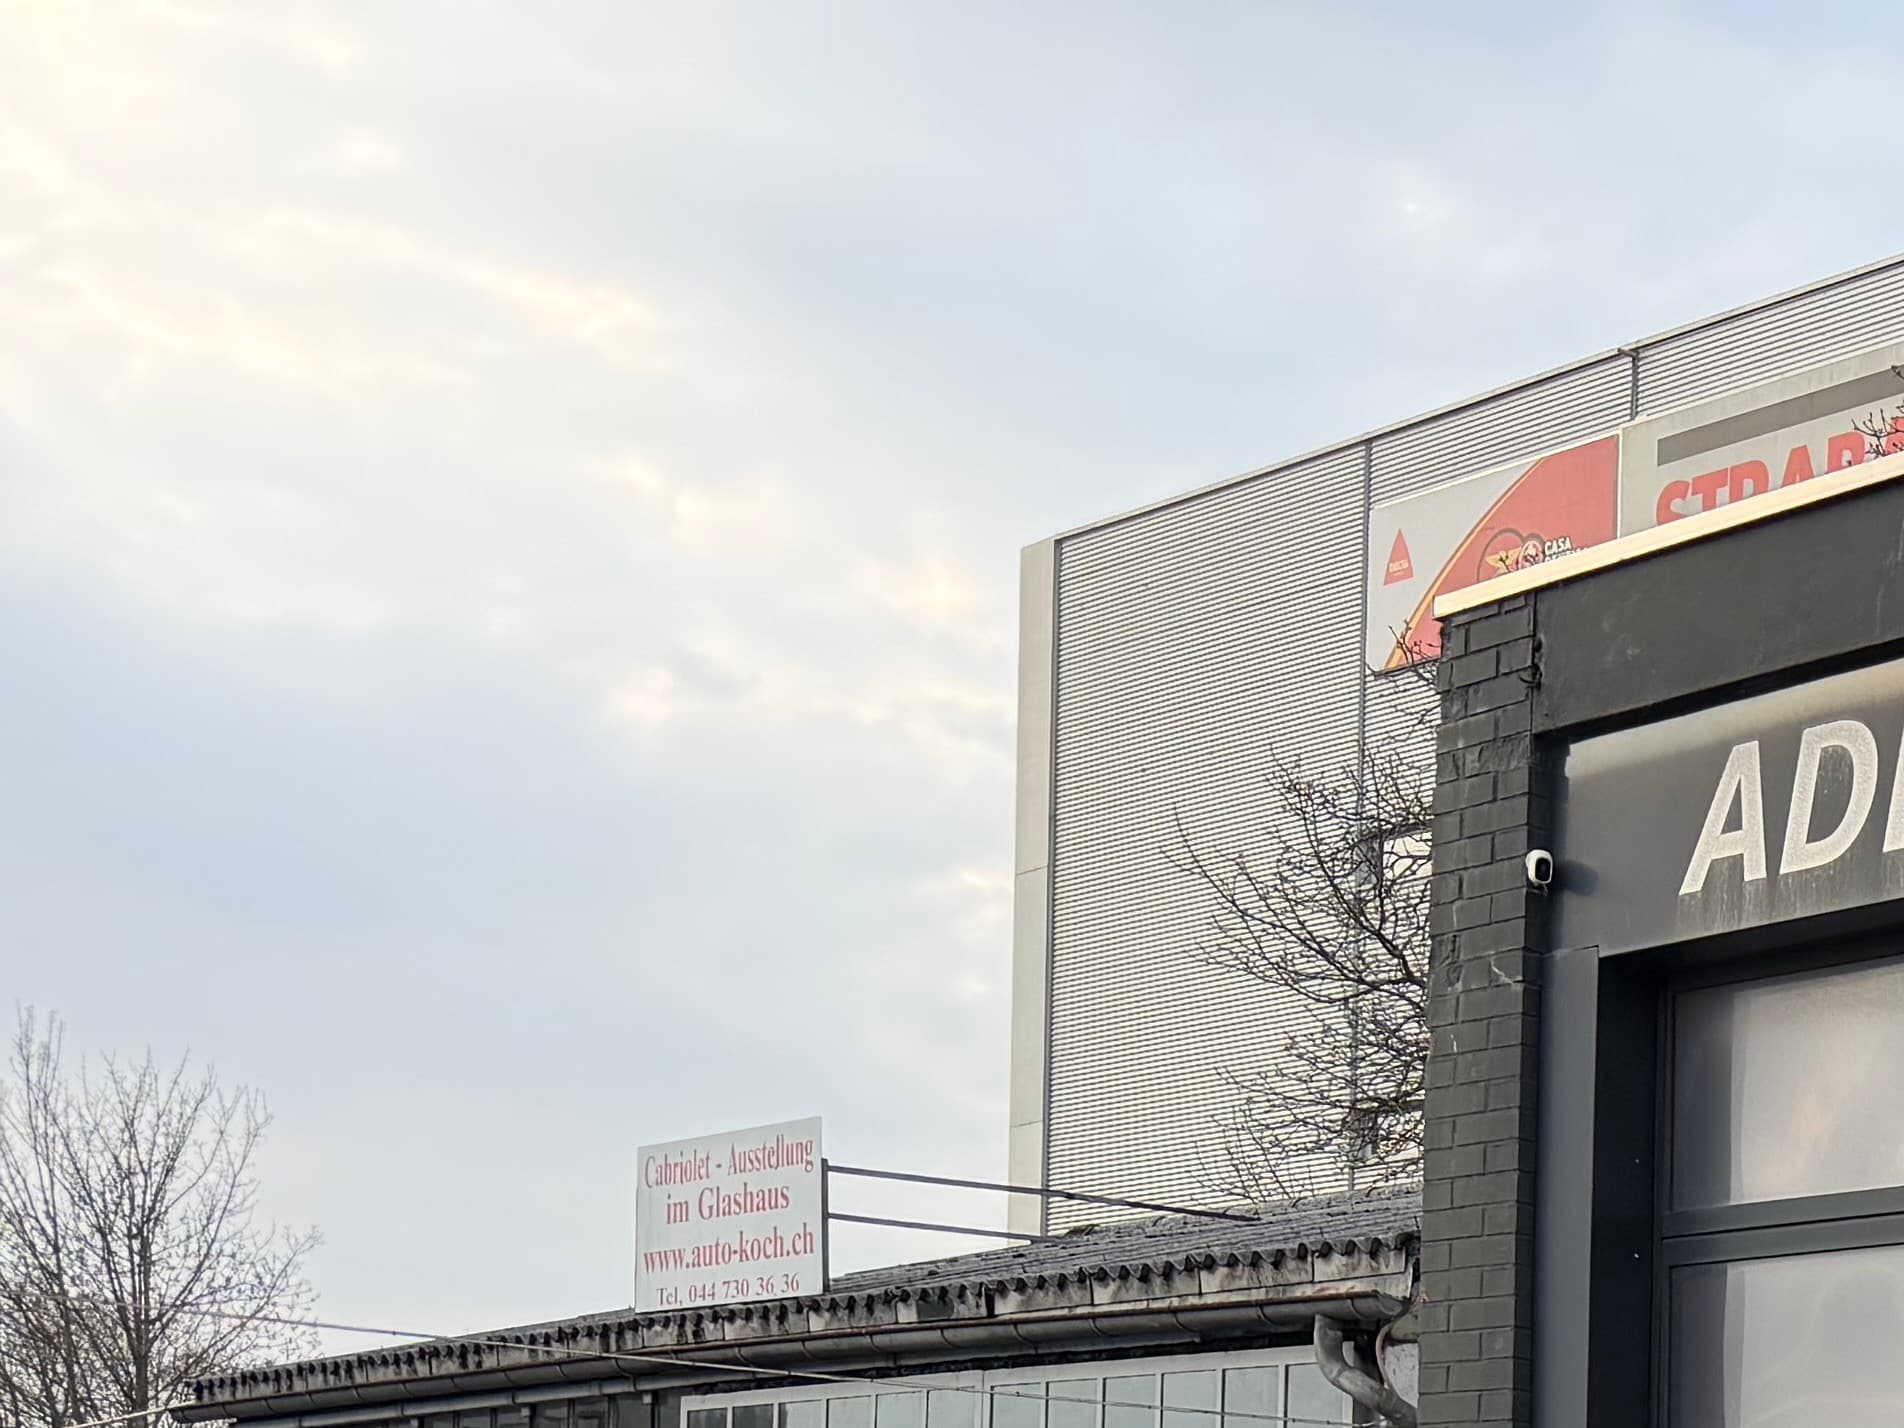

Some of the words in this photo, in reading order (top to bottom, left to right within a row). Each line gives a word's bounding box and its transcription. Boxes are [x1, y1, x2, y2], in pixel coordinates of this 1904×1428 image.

[1544, 536, 1572, 555] CASA
[644, 1149, 710, 1188] Cabriolet
[727, 1134, 814, 1176] Ausstellung
[666, 1193, 690, 1225] im
[698, 1182, 790, 1221] Glashaus
[644, 1222, 814, 1275] www.auto-koch.ch
[689, 1282, 716, 1303] 044
[722, 1278, 750, 1299] 730
[756, 1275, 774, 1296] 36
[781, 1272, 800, 1293] 36
